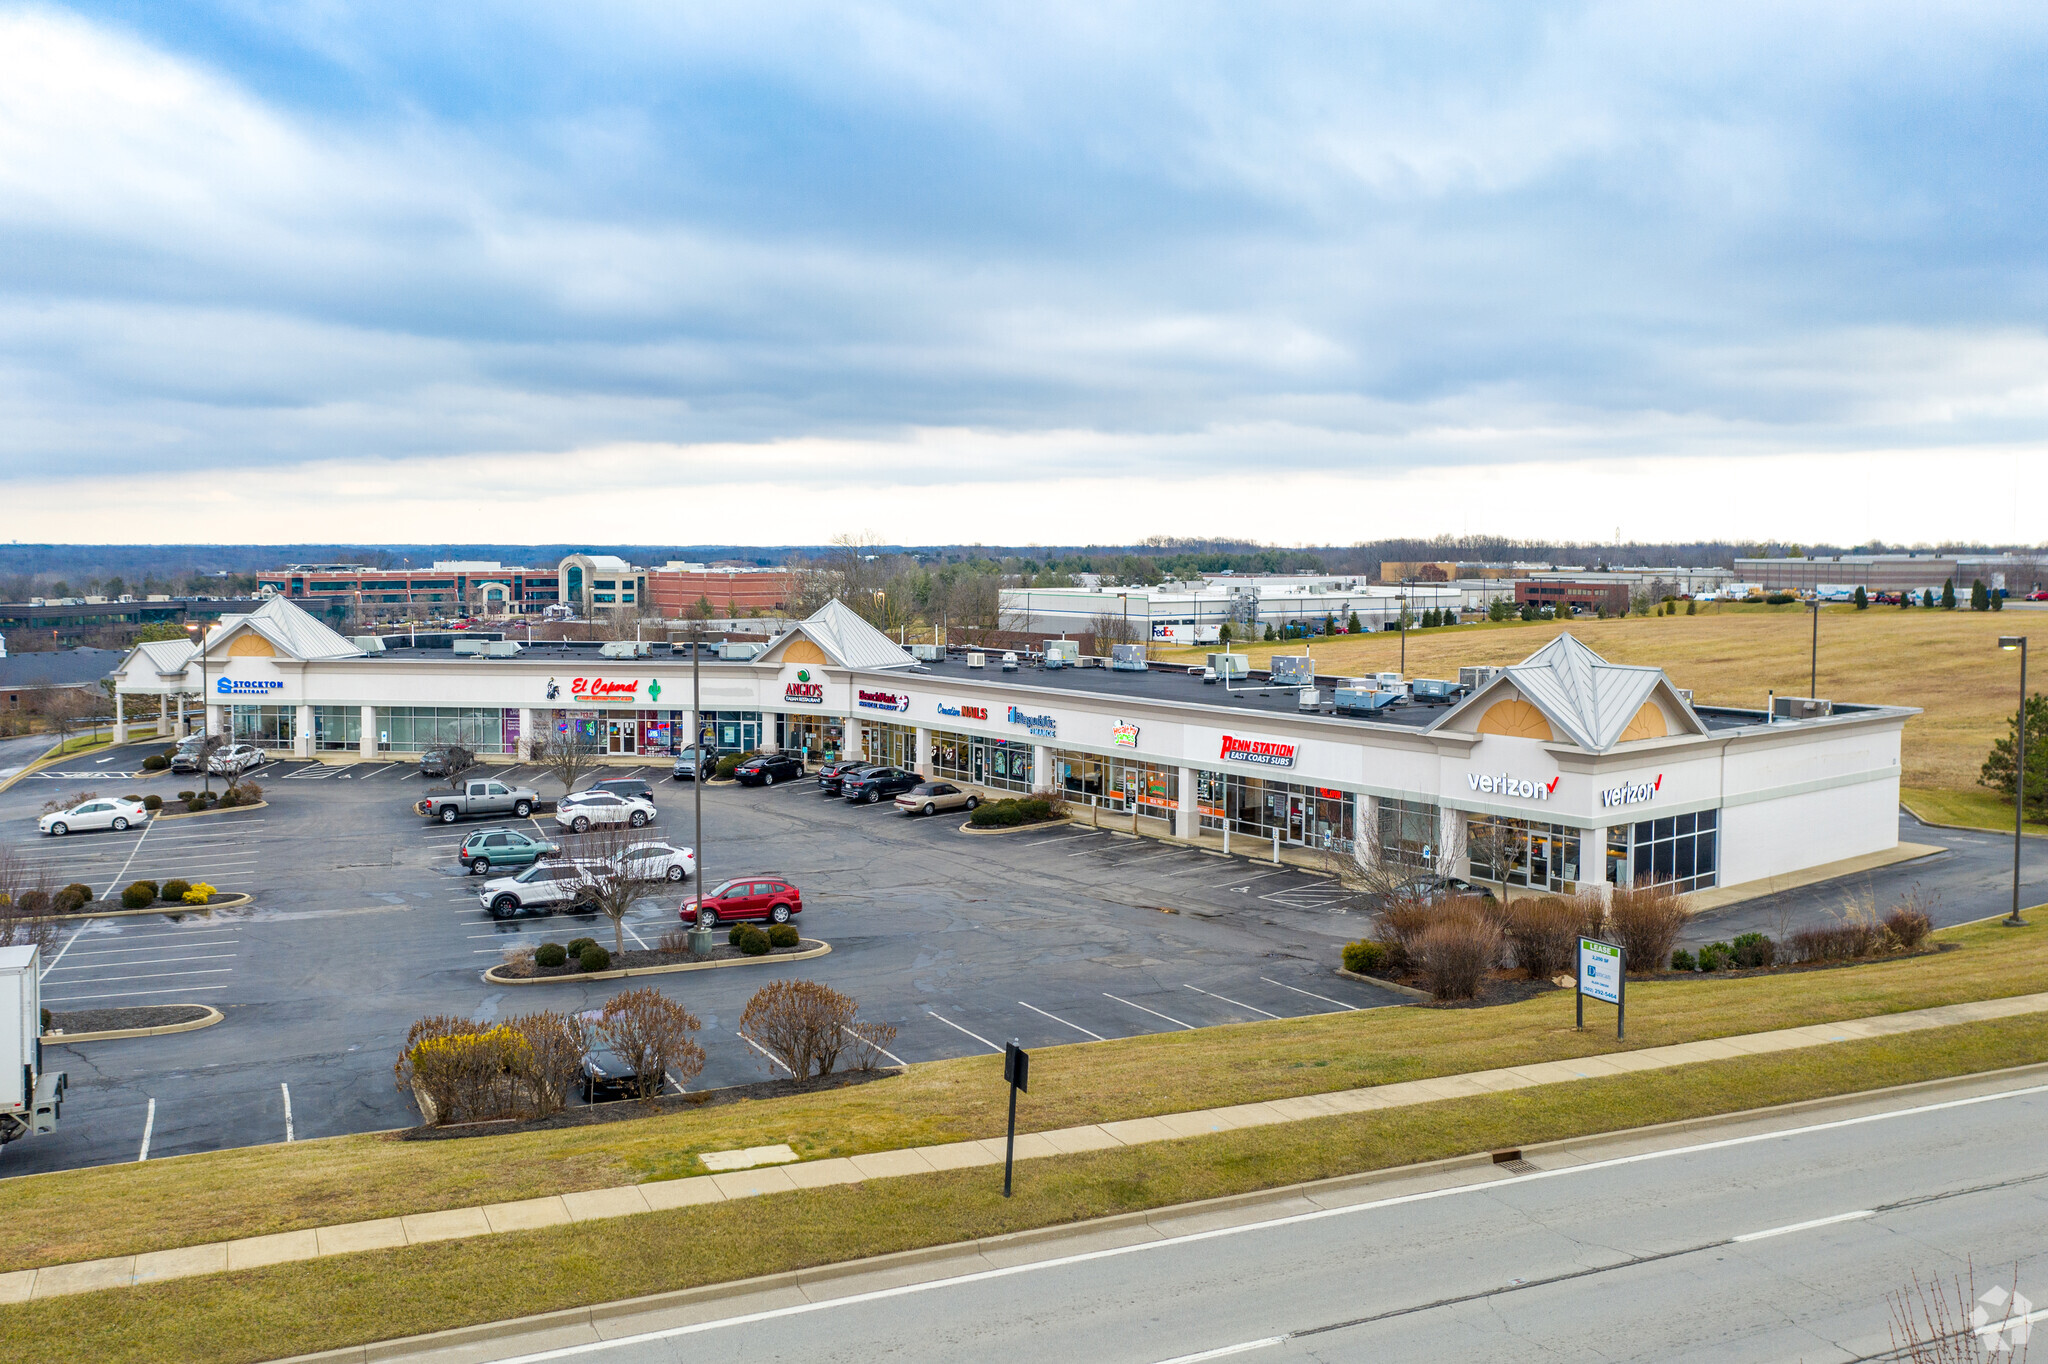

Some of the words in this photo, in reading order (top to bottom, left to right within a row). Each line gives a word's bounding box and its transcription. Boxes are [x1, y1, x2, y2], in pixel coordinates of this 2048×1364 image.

[1153, 627, 1174, 636] FedEx
[571, 677, 588, 693] El
[590, 678, 639, 695] Caporal
[785, 682, 823, 697] ANGIO'S
[858, 689, 898, 704] BenchMark
[937, 702, 960, 717] Creative
[961, 705, 988, 720] NAILS
[1015, 711, 1057, 729] Republic
[1220, 735, 1251, 759] PENN
[1251, 741, 1295, 757] STATION
[1230, 751, 1248, 760] EAST
[1248, 753, 1271, 763] COAST
[1270, 756, 1290, 766] SUBS
[1467, 773, 1549, 800] verizon
[1602, 780, 1657, 808] verizon
[1590, 944, 1612, 954] LEASE
